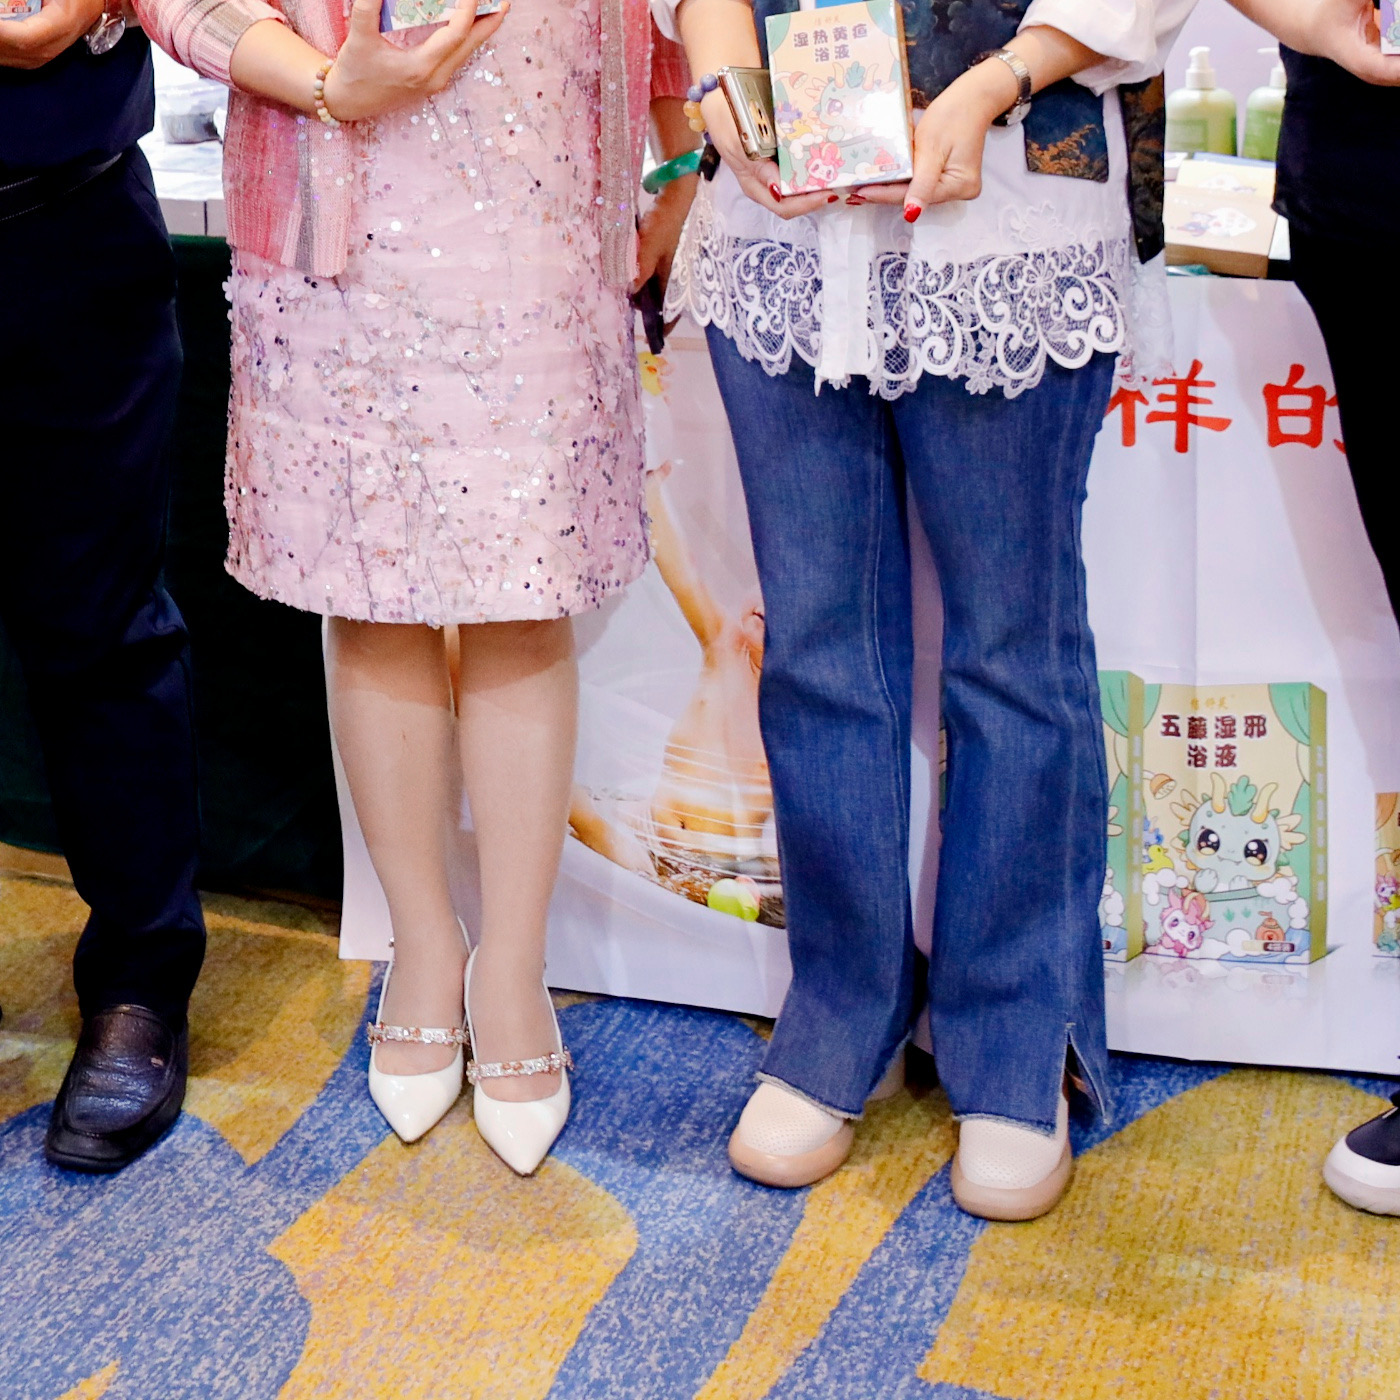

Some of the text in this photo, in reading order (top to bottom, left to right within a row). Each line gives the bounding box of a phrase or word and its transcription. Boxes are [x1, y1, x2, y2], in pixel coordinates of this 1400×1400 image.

[794, 23, 868, 48] 湿热黄疸
[814, 44, 850, 63] 浴液
[1187, 743, 1237, 769] 浴液
